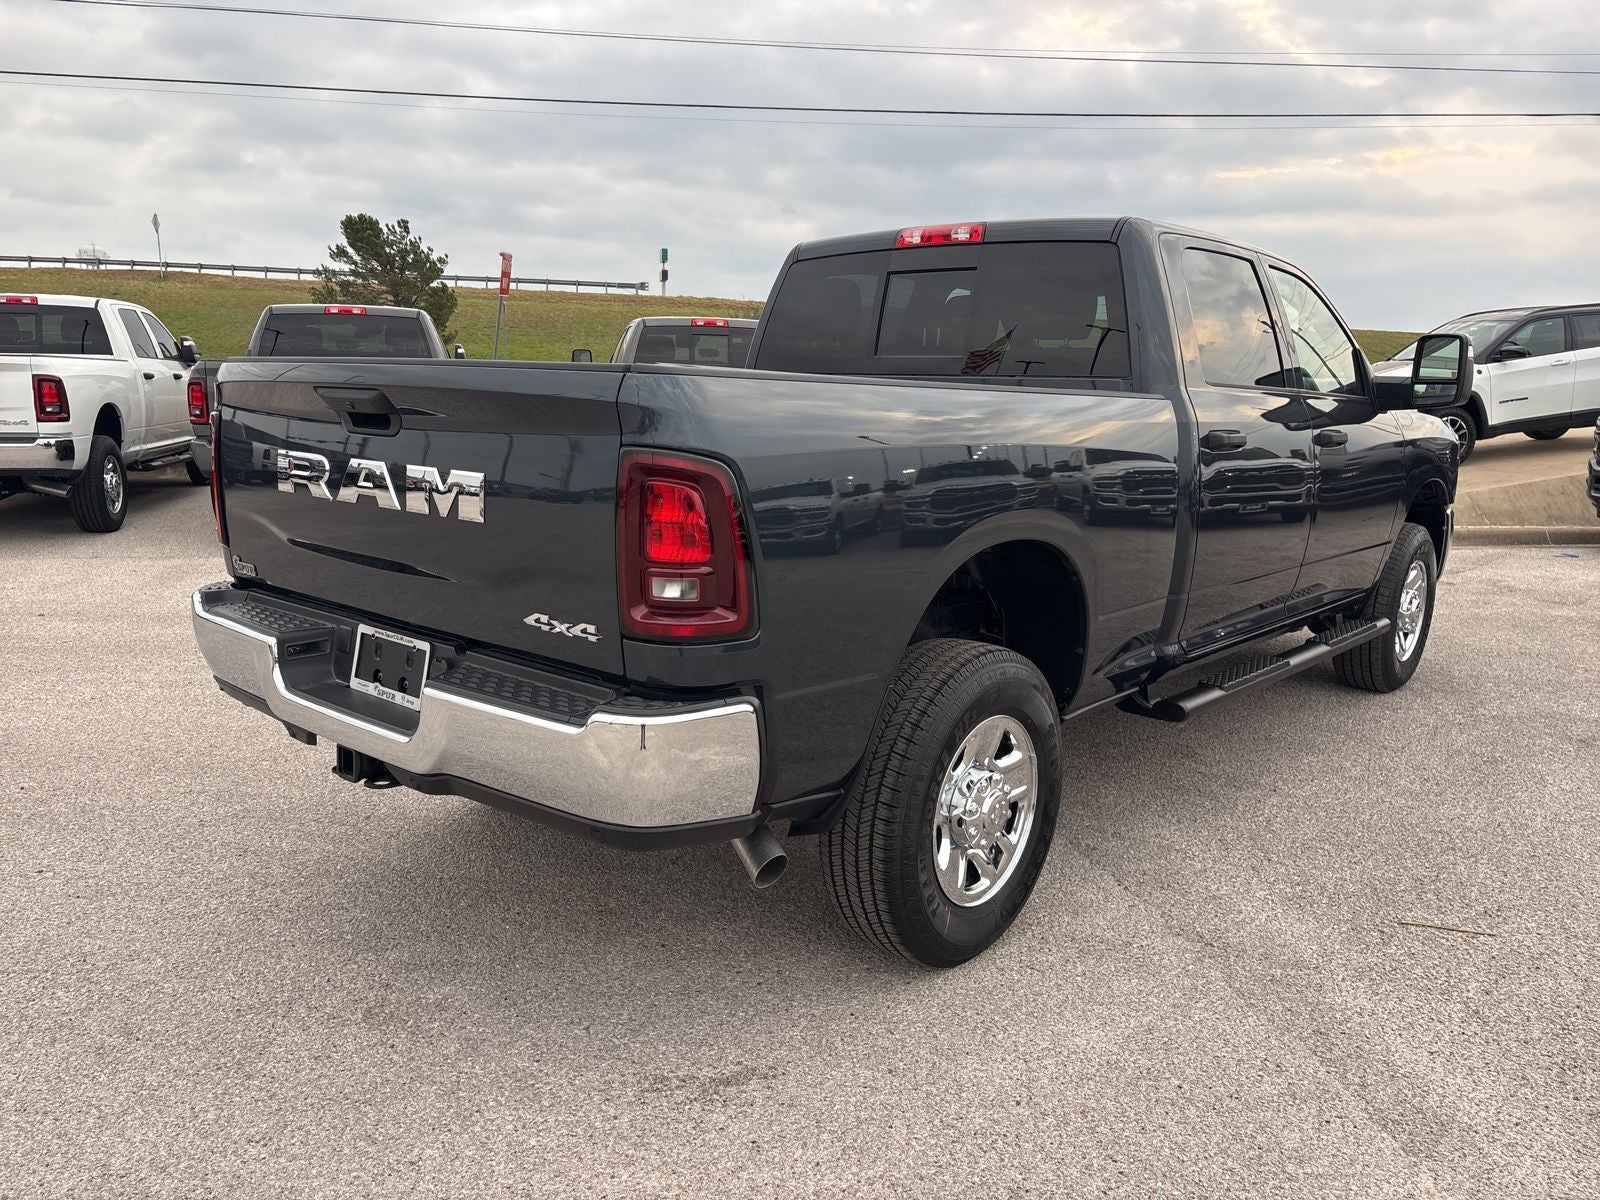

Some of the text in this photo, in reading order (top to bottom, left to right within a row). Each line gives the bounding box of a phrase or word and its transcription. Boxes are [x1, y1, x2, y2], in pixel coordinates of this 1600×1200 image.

[277, 449, 486, 524] RAM
[237, 562, 255, 576] SPUR
[522, 612, 604, 643] 4x4
[376, 688, 396, 701] SPUR
